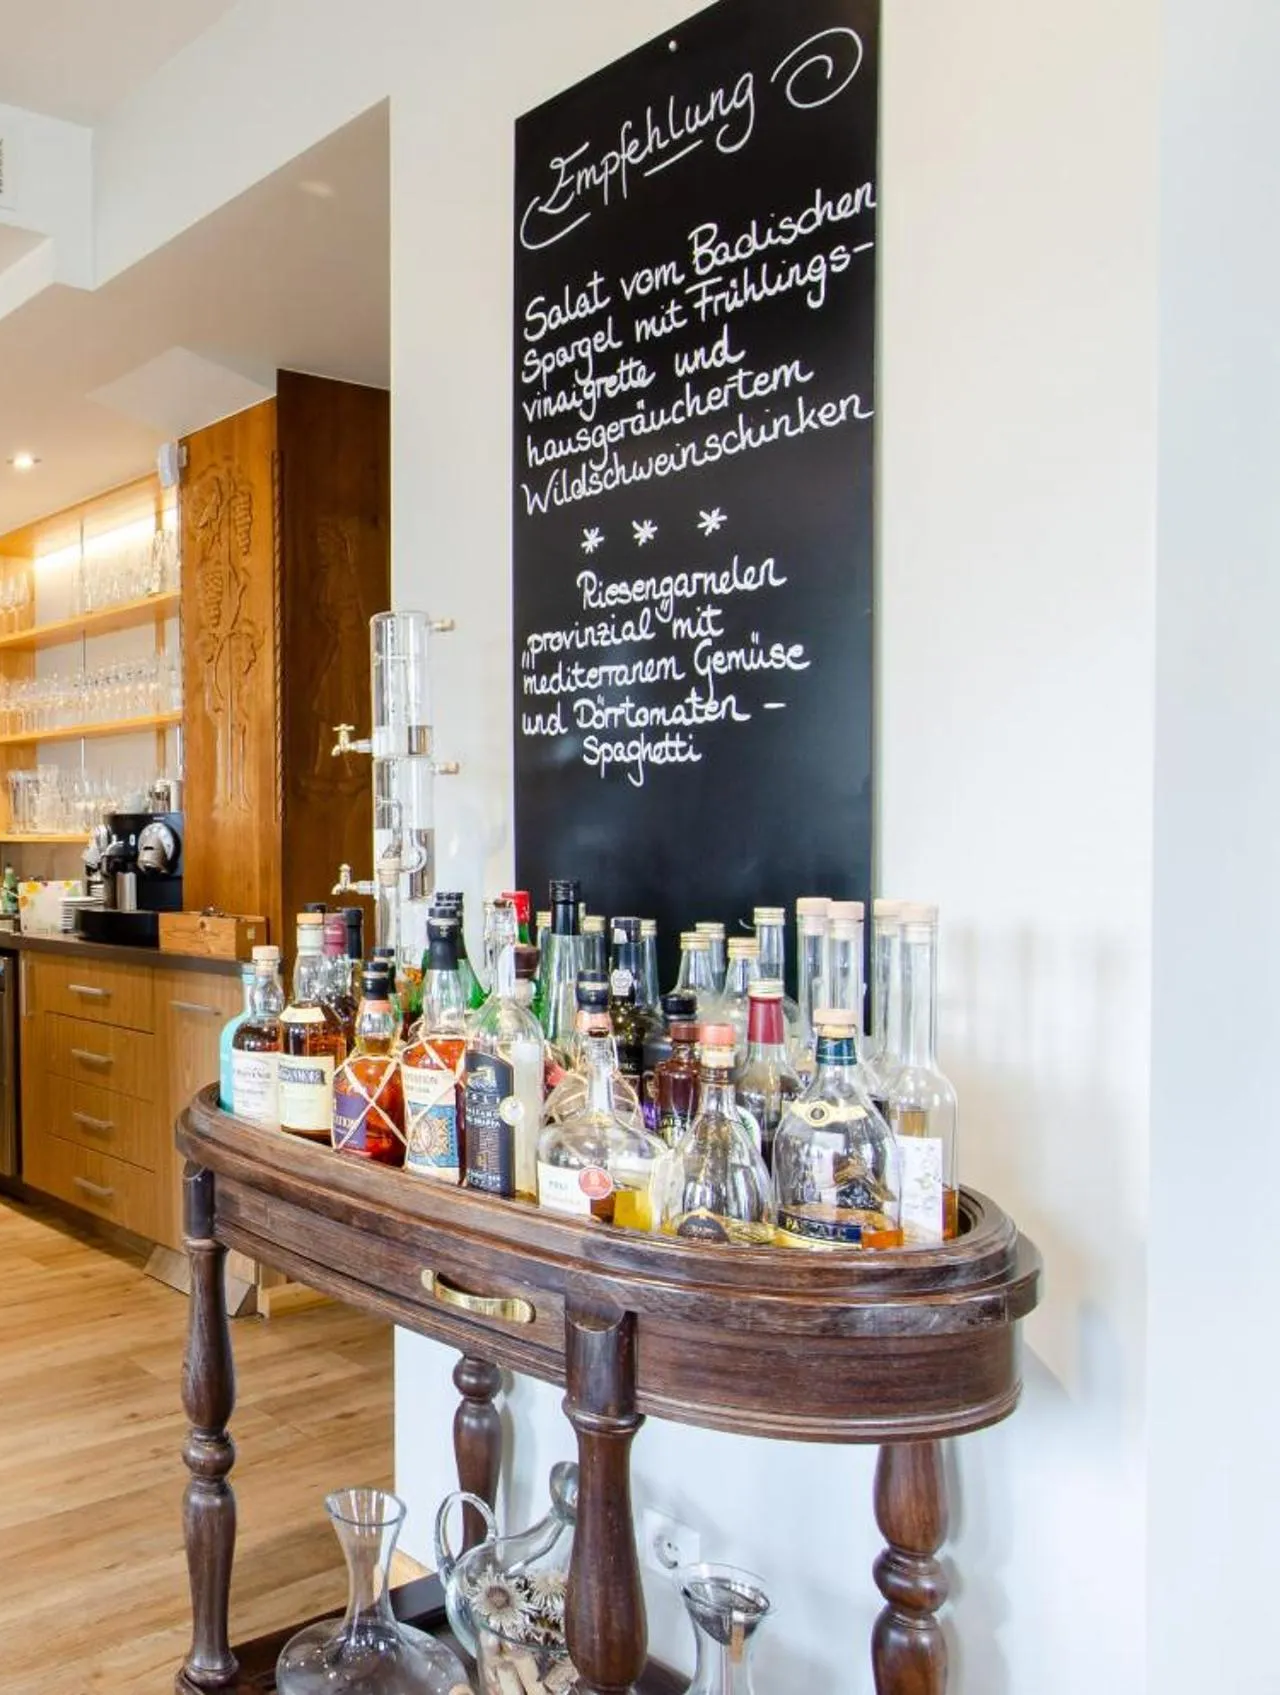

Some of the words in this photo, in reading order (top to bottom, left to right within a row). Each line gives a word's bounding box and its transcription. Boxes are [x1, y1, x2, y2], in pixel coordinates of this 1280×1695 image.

[538, 72, 754, 214] Empfehlung
[523, 270, 611, 342] Salat
[620, 261, 685, 301] vom
[687, 182, 877, 276] Badischen
[521, 315, 623, 392] Spargel
[634, 299, 688, 343] mit
[684, 241, 875, 323] Frühlings-
[522, 356, 656, 423] vinaigrette
[674, 322, 746, 378] und
[526, 359, 814, 472] hausgeräuchertem
[520, 392, 874, 516] Wildschweinschinken
[576, 554, 788, 624] Riesengarnelen
[672, 604, 725, 641] mit
[521, 700, 569, 736] und
[572, 686, 752, 730] Dörrtomaten
[523, 654, 687, 695] mediterranem
[693, 630, 812, 707] Gemüse
[582, 731, 703, 788] Spaghetti
